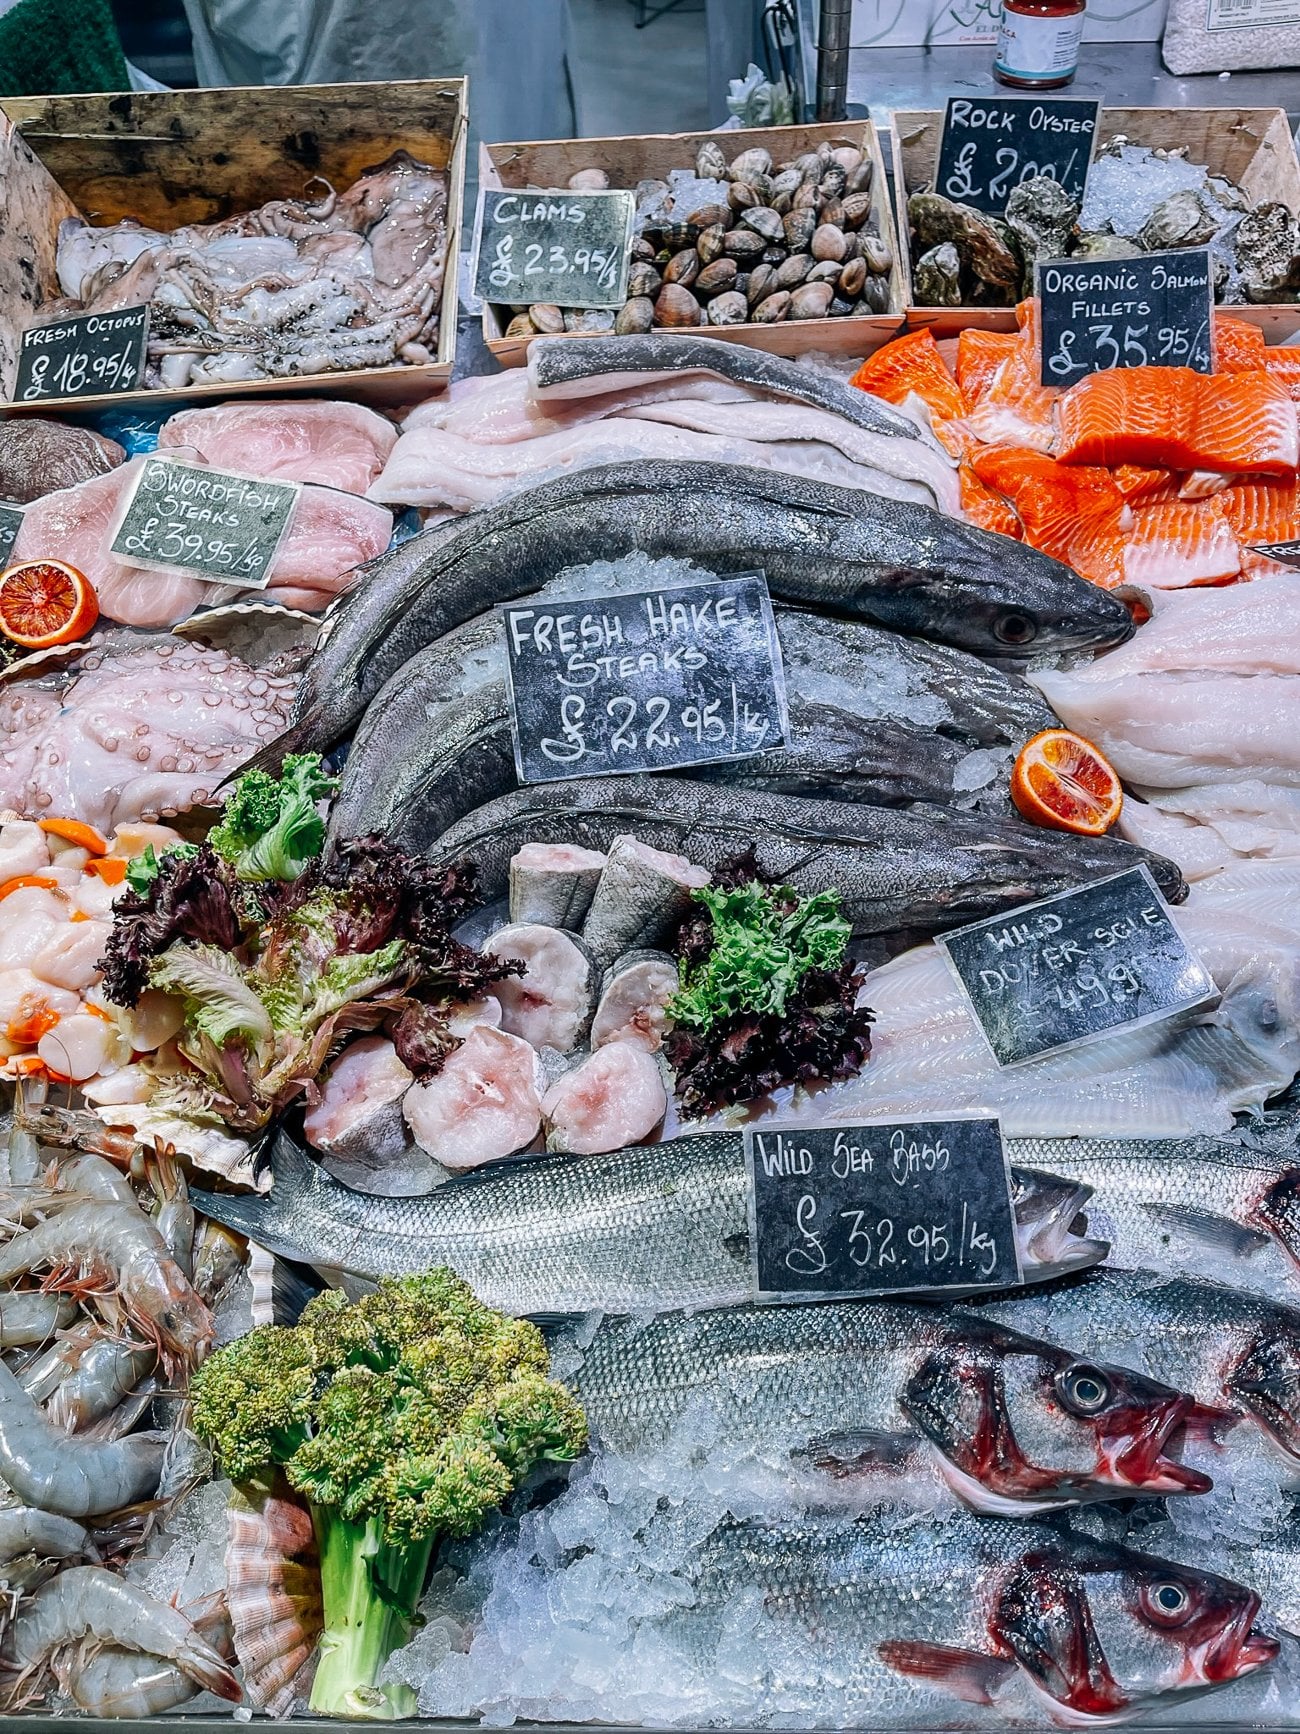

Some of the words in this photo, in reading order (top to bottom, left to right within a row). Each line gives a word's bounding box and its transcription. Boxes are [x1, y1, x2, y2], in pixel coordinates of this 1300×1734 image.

[950, 100, 1016, 132] ROCK
[1029, 106, 1095, 133] OYSTER
[493, 197, 586, 223] CLAMS
[1046, 268, 1139, 293] ORGANIC
[1151, 265, 1208, 290] SALMON
[1072, 301, 1151, 318] FILLETS
[25, 324, 77, 347] FRESH
[86, 314, 145, 334] OCTOPUS
[143, 462, 280, 511] SWORDFISH
[156, 495, 240, 527] STEAKS
[509, 609, 624, 656] FRESH
[646, 595, 738, 637] HAKE
[555, 646, 709, 688] STEAKS
[979, 939, 1088, 995] DOVER
[832, 1132, 874, 1179] SEA
[890, 1129, 950, 1186] BASS
